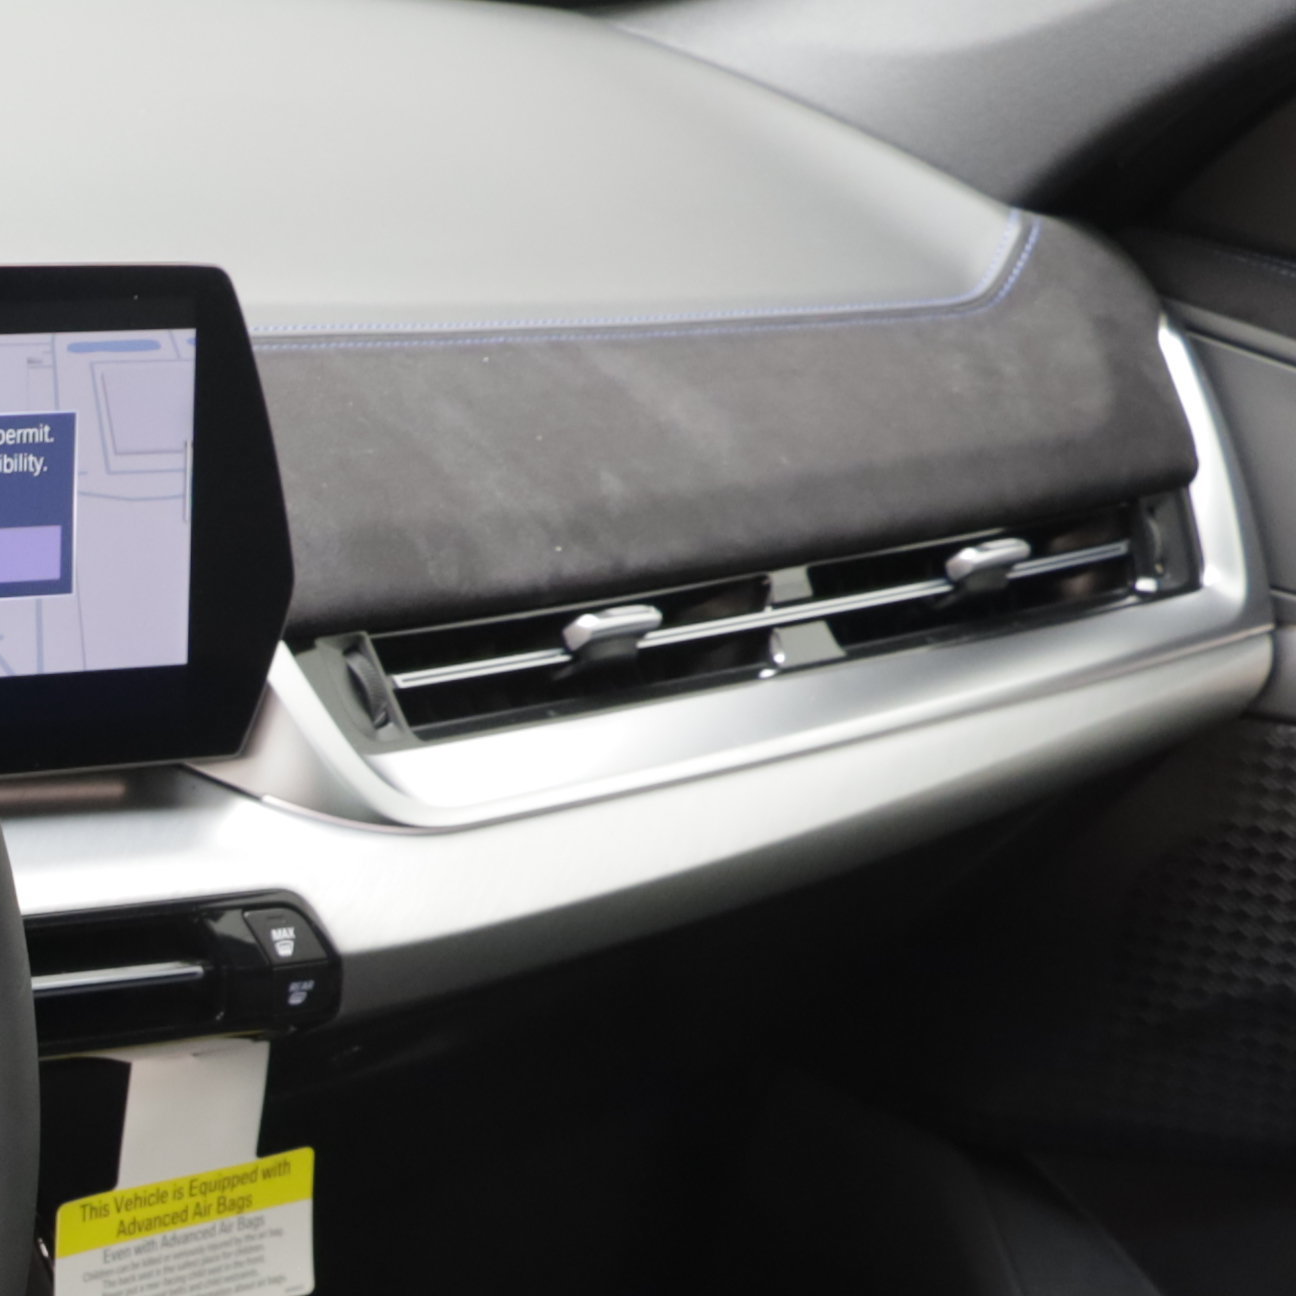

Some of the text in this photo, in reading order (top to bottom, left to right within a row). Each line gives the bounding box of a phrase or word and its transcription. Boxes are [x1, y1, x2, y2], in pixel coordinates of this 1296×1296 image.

[270, 926, 296, 941] MAX
[80, 1159, 291, 1222] This Vehicle is Equipped with
[116, 1192, 252, 1238] Advanced Air Bags
[103, 1246, 131, 1264] Even
